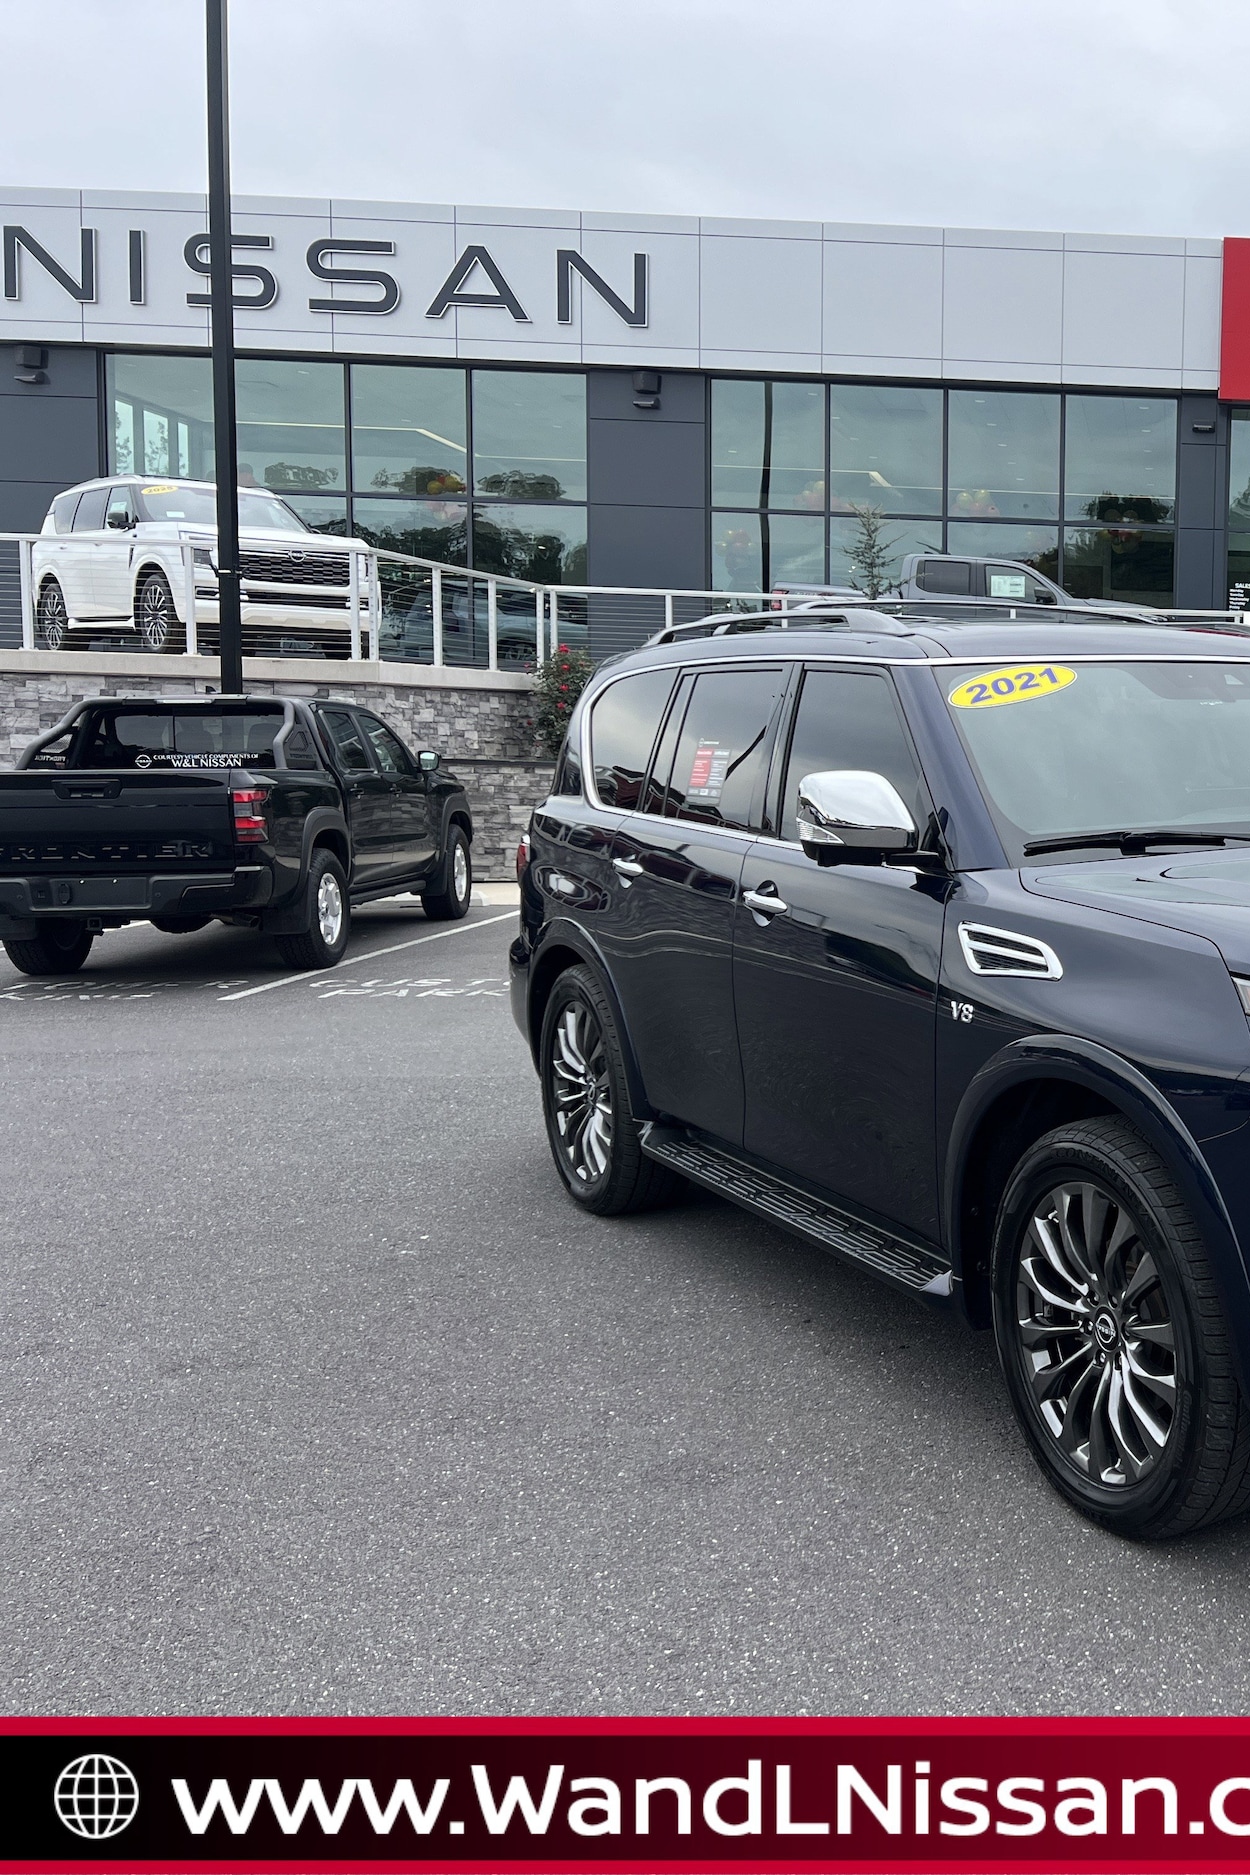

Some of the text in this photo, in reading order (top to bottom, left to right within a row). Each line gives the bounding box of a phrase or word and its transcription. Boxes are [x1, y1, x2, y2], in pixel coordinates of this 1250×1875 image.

[2, 225, 649, 329] NISSAN
[966, 667, 1058, 704] 2021
[171, 758, 242, 768] W&L NISSAN
[950, 1000, 974, 1023] V8
